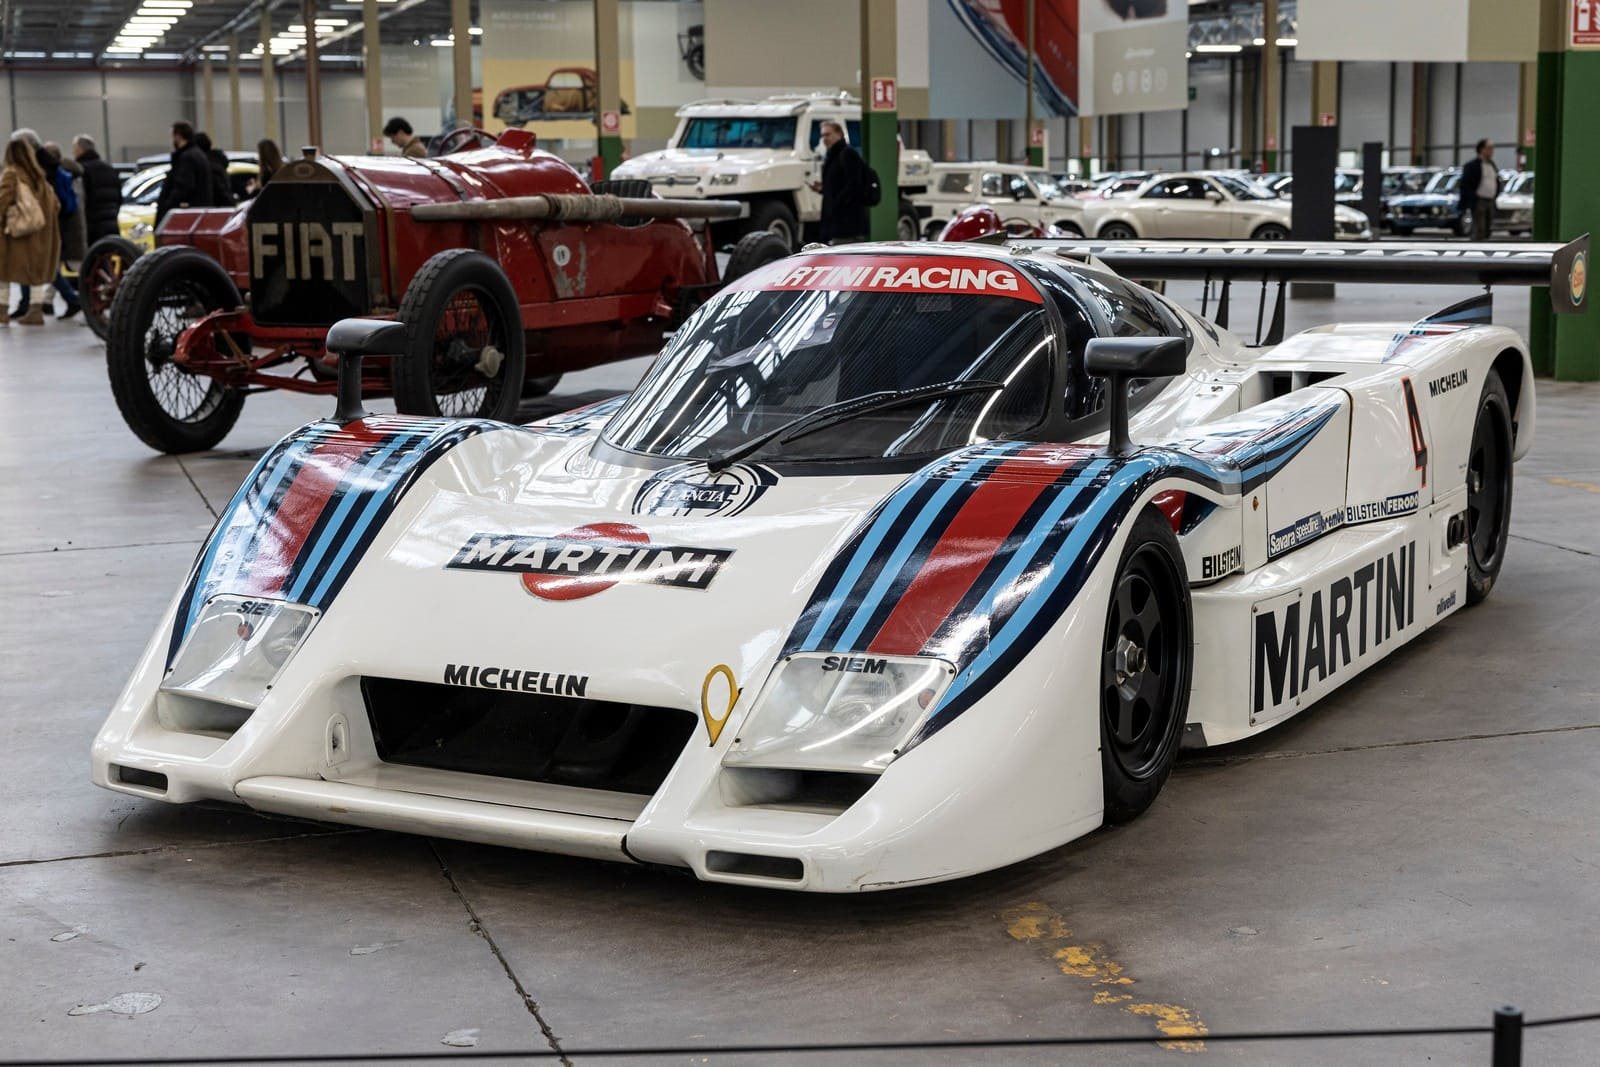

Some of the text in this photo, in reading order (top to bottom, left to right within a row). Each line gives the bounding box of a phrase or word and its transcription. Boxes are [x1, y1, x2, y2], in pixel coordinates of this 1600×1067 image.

[251, 222, 364, 281] FIAT
[745, 266, 1019, 291] ARTINI RACING
[1429, 369, 1468, 397] MICHELIN
[1401, 376, 1427, 488] 4
[666, 490, 725, 502] LNCIA
[1270, 531, 1296, 554] Savara
[1346, 501, 1388, 522] BILSTEIN
[461, 536, 718, 584] MARTINI
[1202, 544, 1242, 579] BILSTEIN
[1253, 540, 1416, 714] MARTINI
[444, 664, 589, 697] MICHELIN
[821, 656, 888, 675] SIEM
